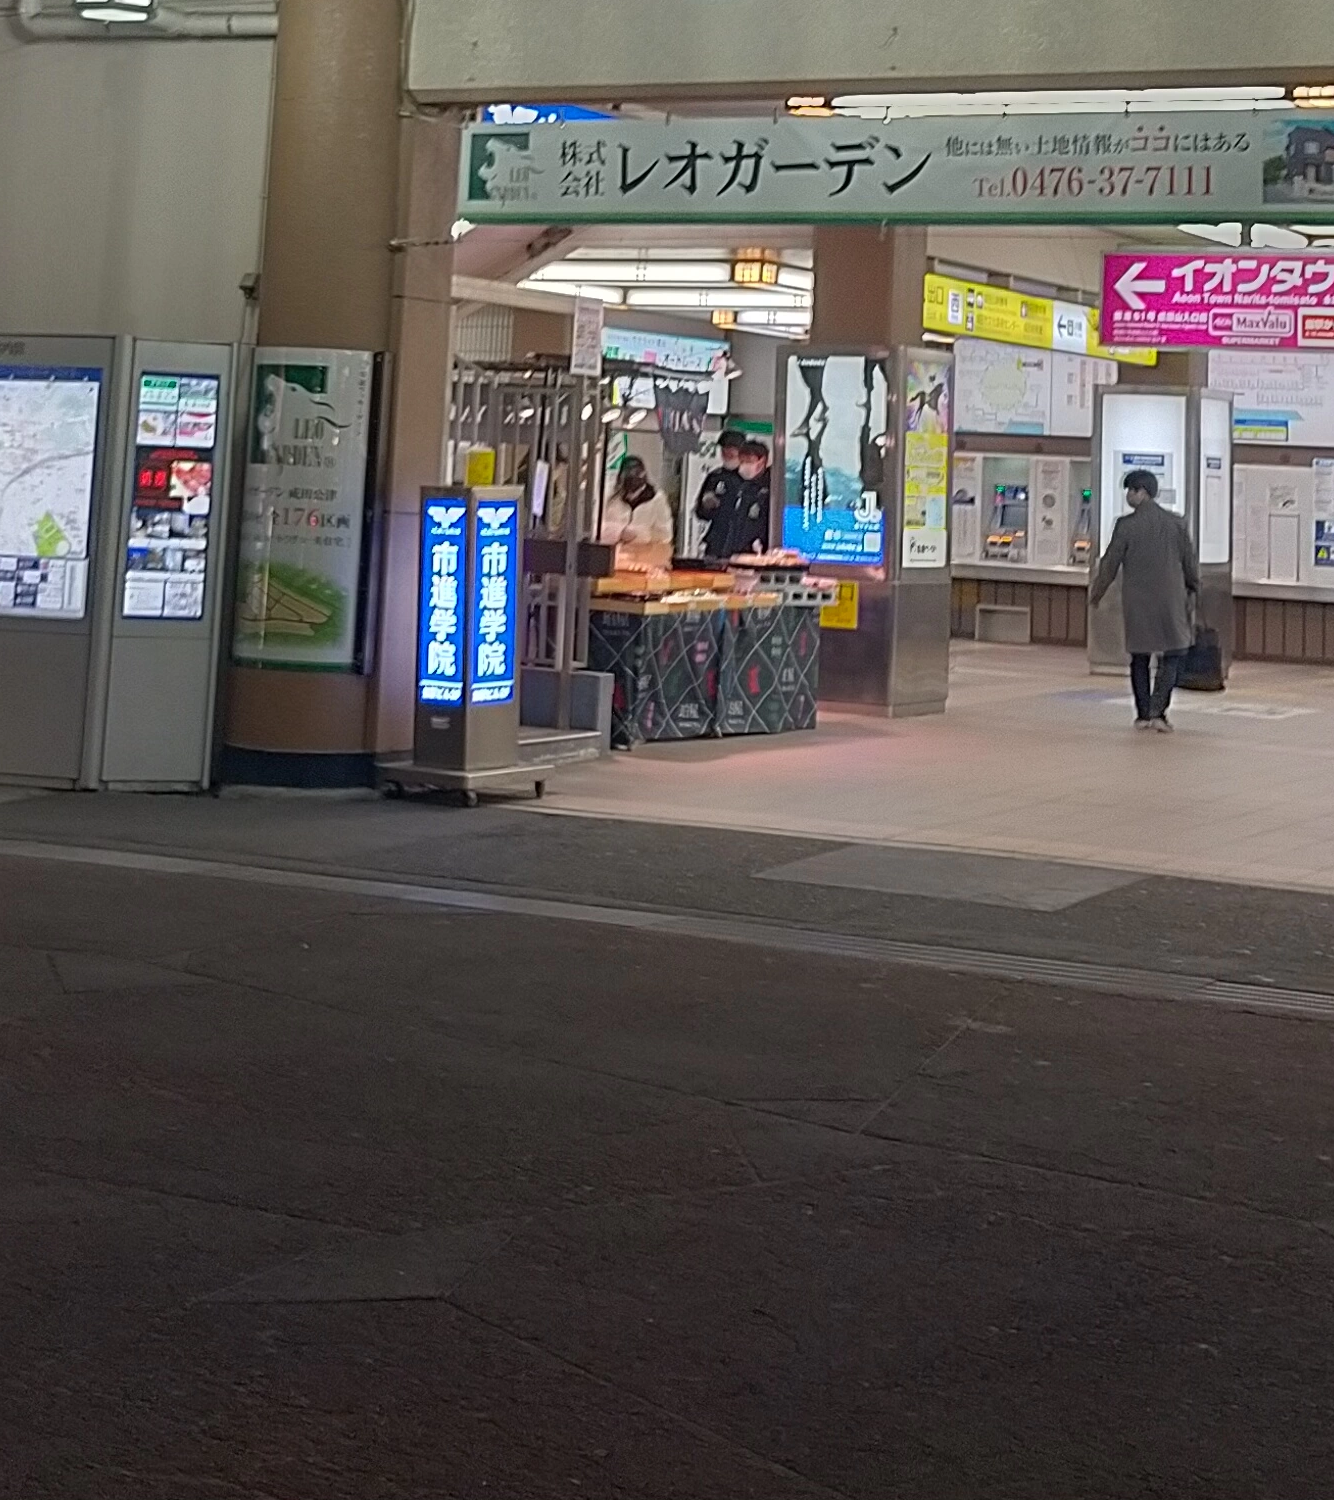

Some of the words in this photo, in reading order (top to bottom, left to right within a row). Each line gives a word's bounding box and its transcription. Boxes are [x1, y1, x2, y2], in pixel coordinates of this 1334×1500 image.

[558, 139, 606, 168] 株式
[616, 134, 934, 198] レオガーデン
[558, 171, 606, 199] 会社
[1235, 308, 1288, 331] MaxValu
[427, 540, 460, 677] 市進学院
[477, 541, 509, 678] 市進学院
